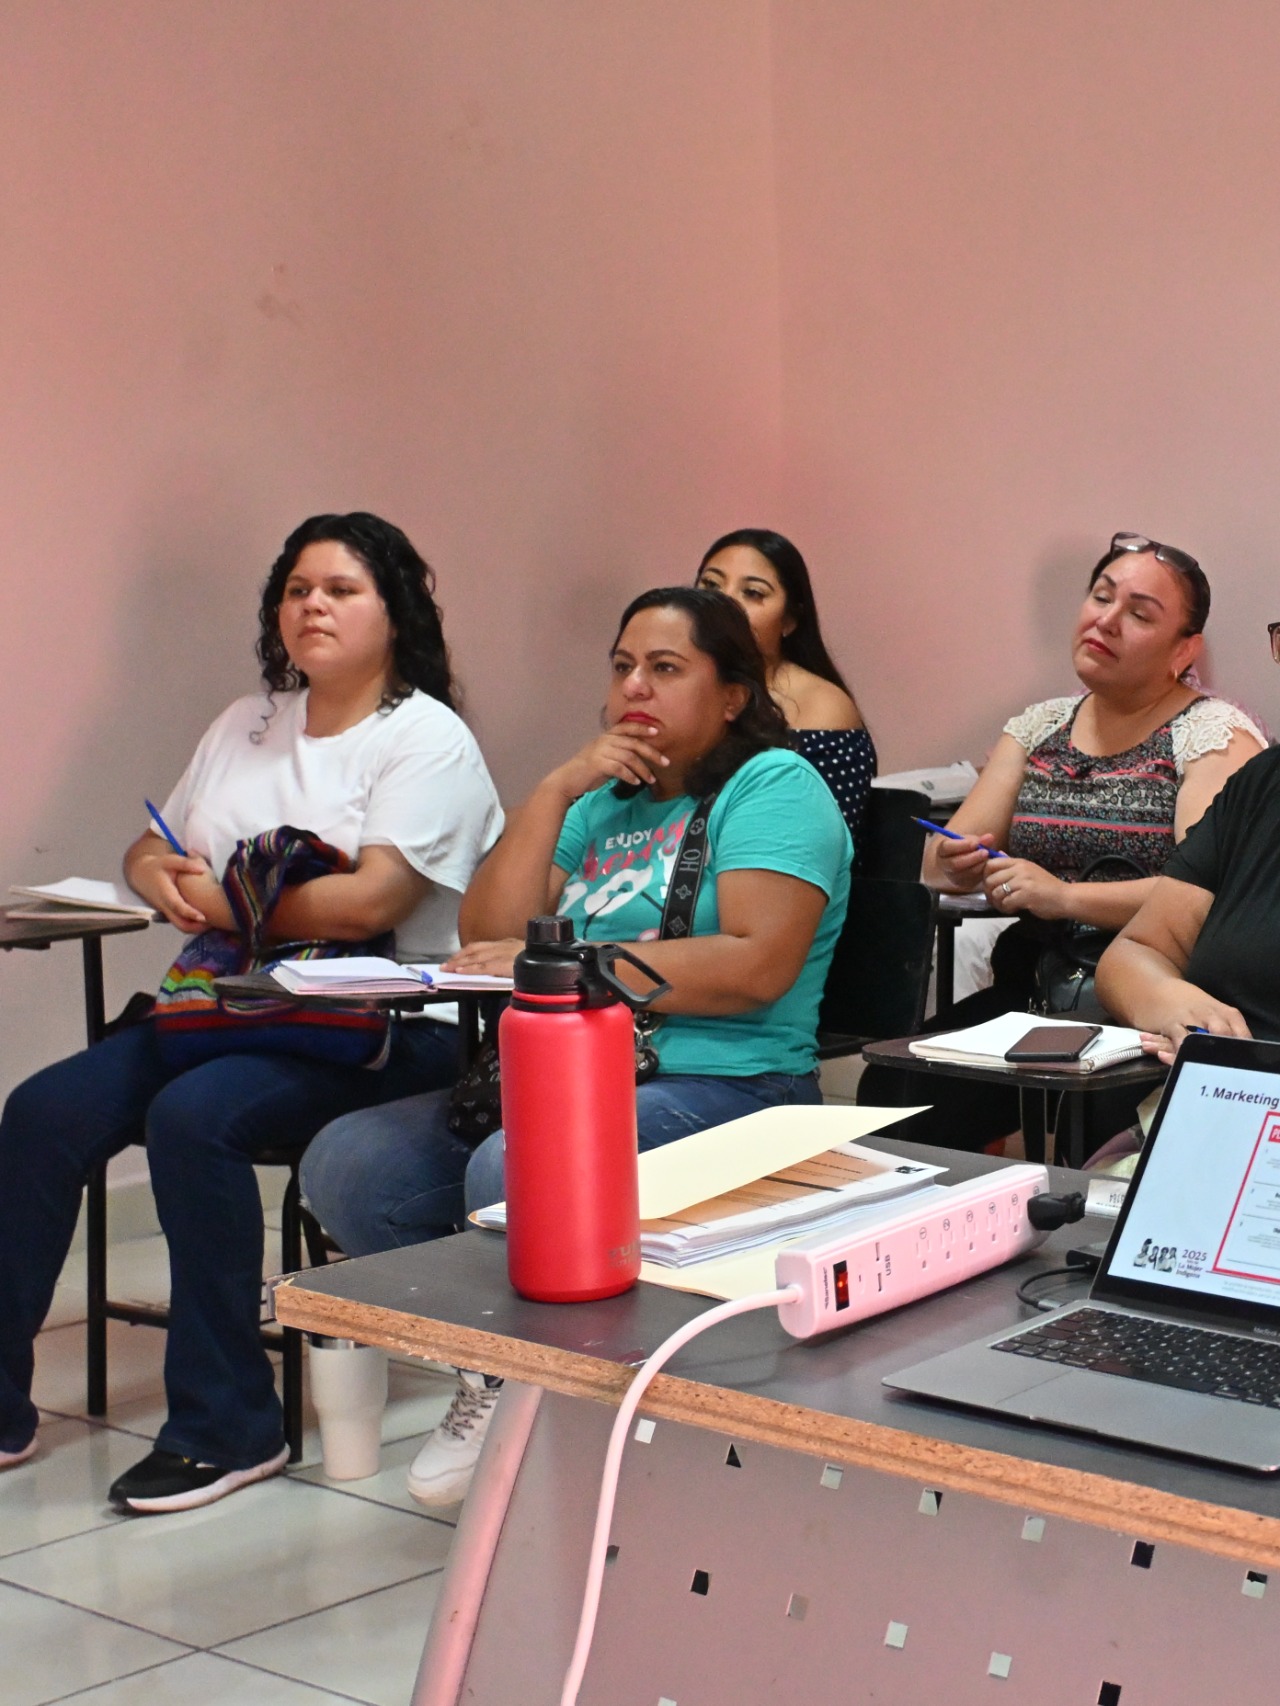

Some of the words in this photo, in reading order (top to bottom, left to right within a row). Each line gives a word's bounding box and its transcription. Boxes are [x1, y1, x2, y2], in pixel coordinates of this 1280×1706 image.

[605, 828, 653, 850] ENJOY
[1199, 1085, 1209, 1098] 1.
[1213, 1086, 1280, 1110] Marketing
[884, 1254, 892, 1277] USB
[1181, 1249, 1208, 1262] 2025
